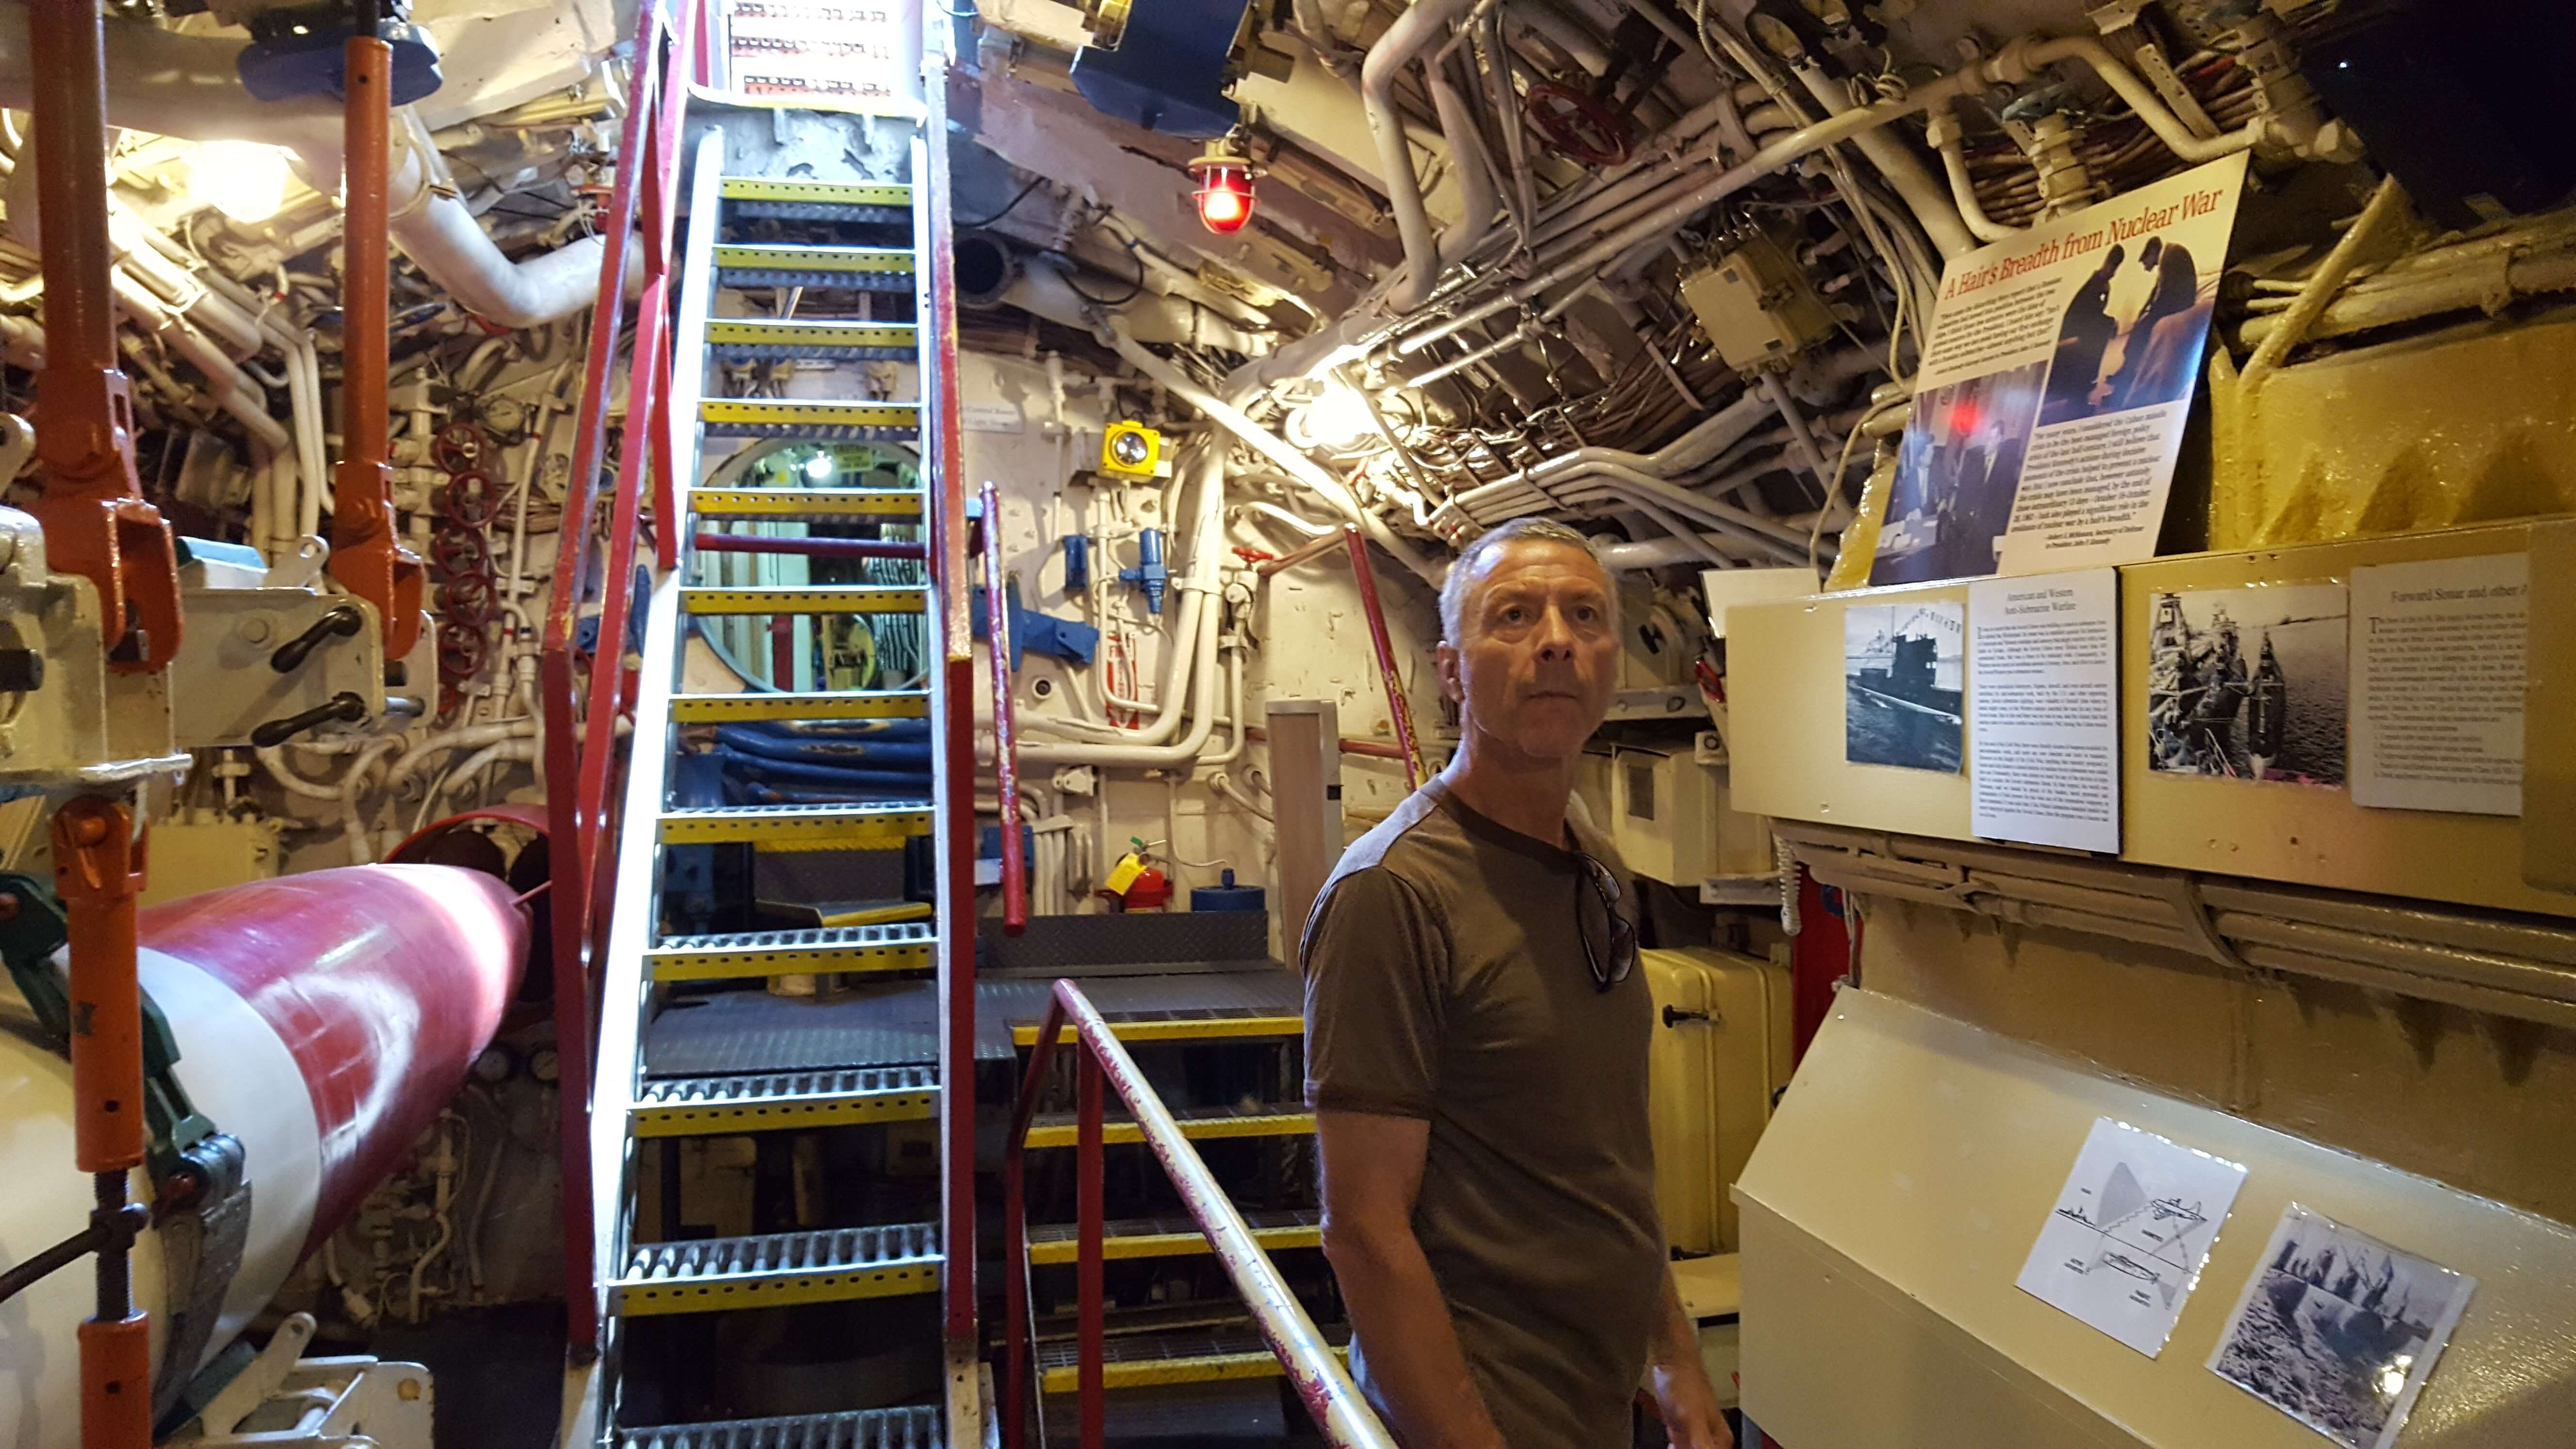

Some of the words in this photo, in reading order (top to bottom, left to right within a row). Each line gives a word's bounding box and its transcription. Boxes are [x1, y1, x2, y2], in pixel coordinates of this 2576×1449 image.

[1944, 277, 1956, 300] A
[1957, 264, 1998, 296] Hair's
[1999, 239, 2060, 281] Breadth
[2061, 230, 2103, 261] from
[2106, 206, 2180, 246] Nuclear
[2181, 189, 2224, 221] War
[2466, 585, 2487, 598] and
